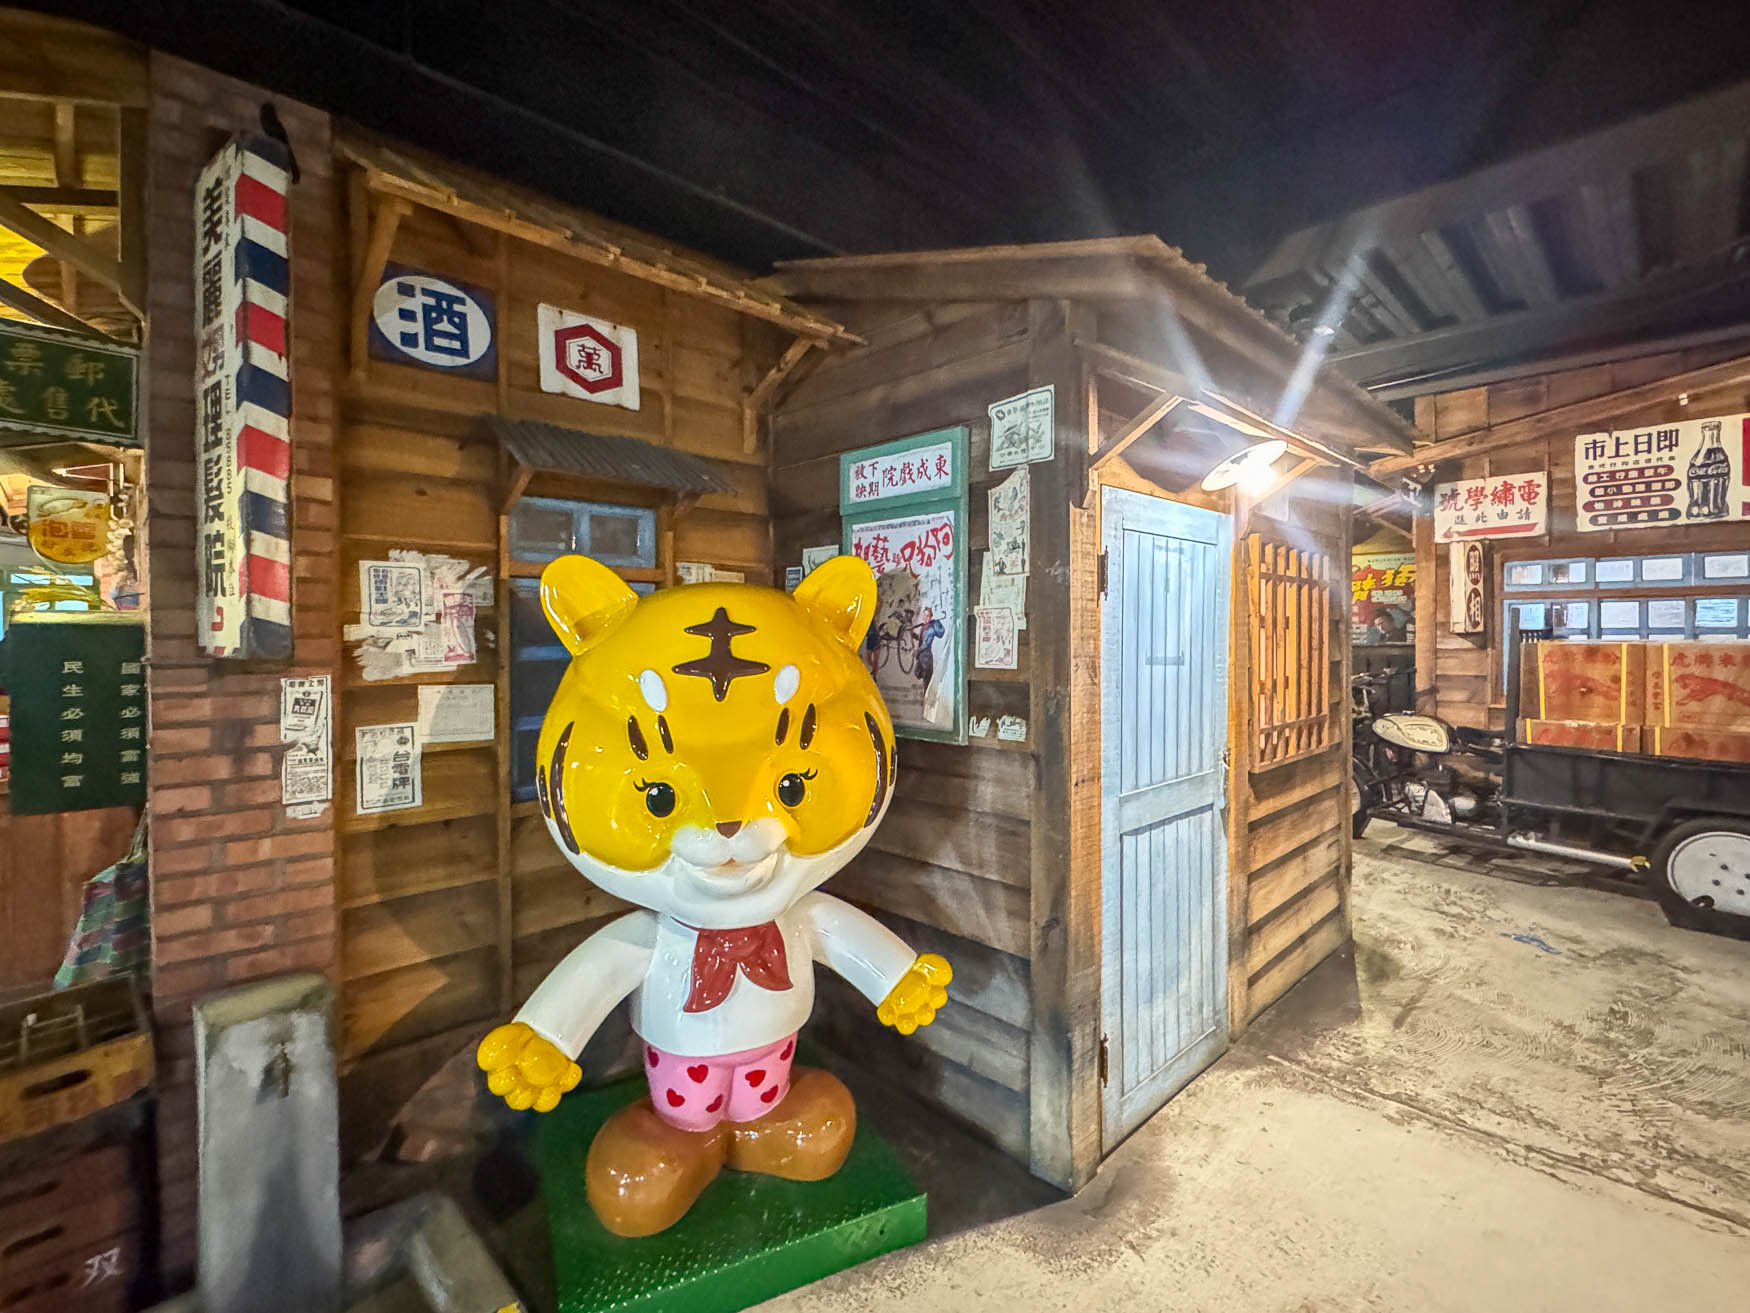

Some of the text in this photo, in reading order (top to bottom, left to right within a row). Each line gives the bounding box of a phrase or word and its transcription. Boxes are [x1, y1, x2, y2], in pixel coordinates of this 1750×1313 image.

[397, 281, 470, 359] 酒
[1583, 428, 1680, 461] 即日上市
[882, 454, 950, 488] 東成戲院
[1454, 506, 1533, 526] 請由此進
[1467, 551, 1482, 625] 照相
